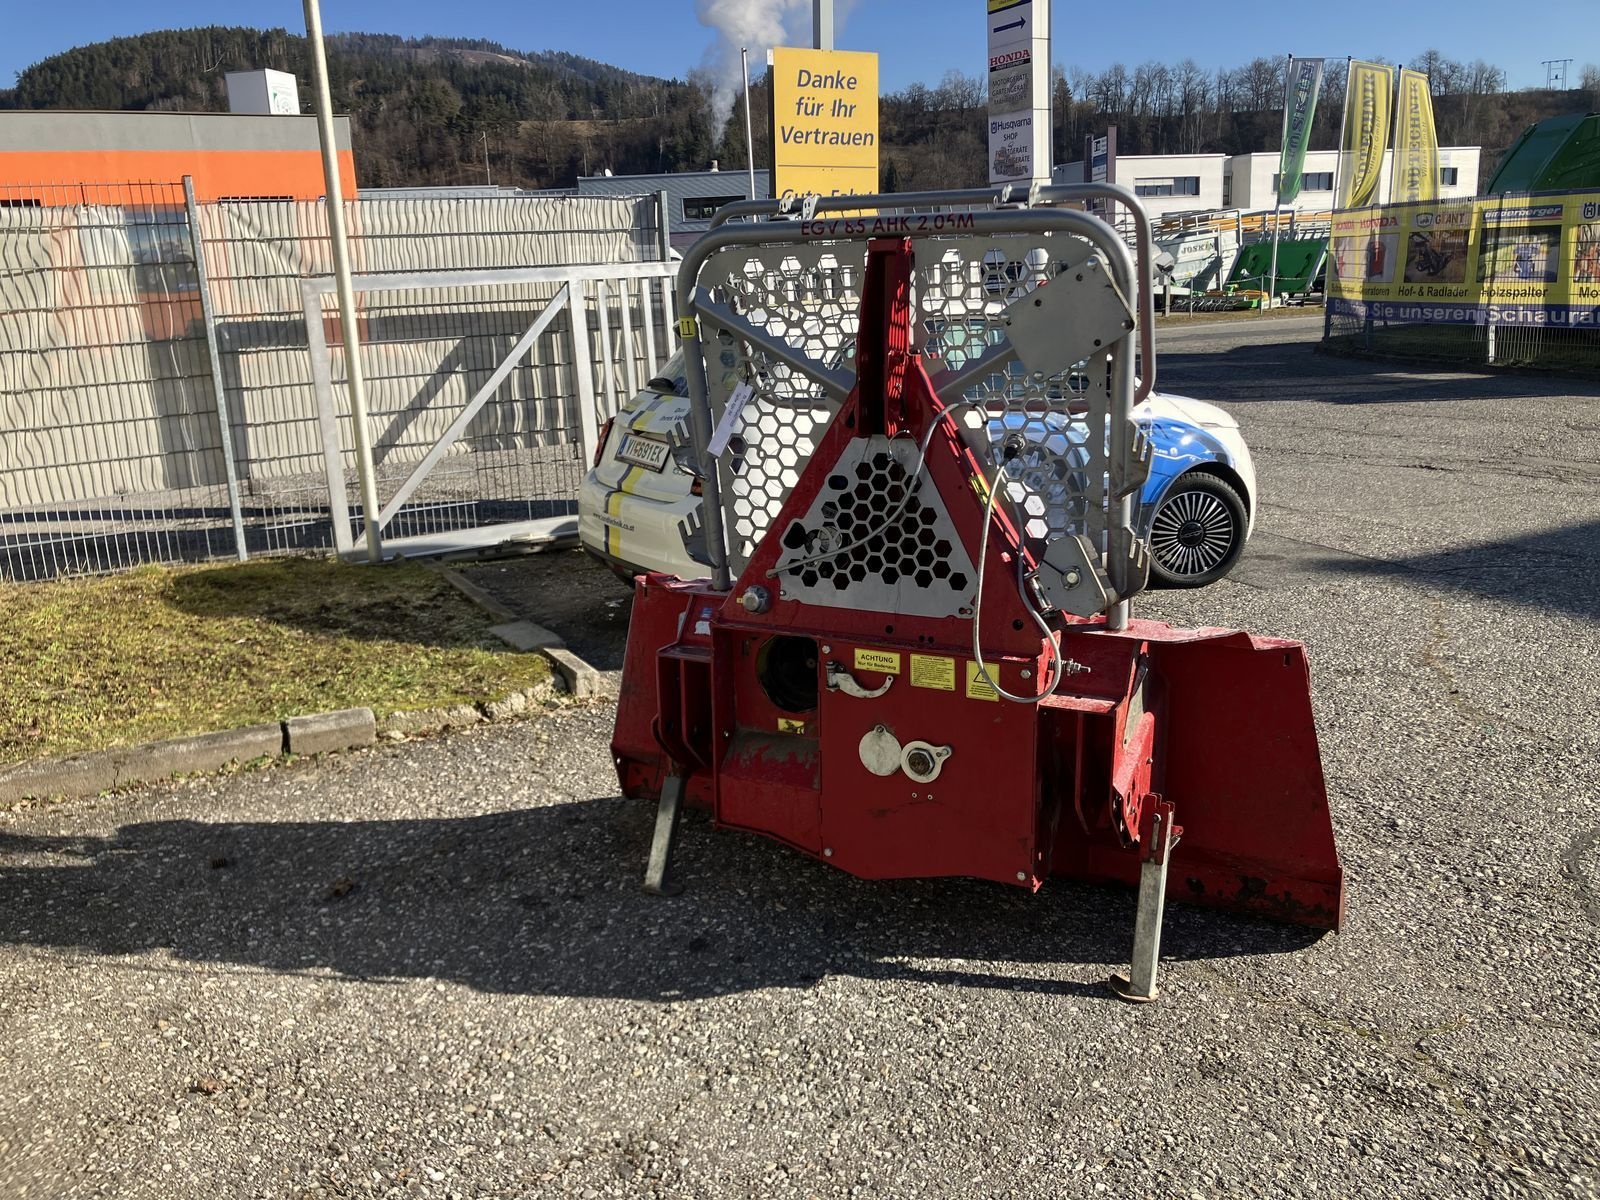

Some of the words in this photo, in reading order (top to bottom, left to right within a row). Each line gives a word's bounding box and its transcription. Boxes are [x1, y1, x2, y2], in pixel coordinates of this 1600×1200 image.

[990, 49, 1030, 66] HONDA
[797, 69, 857, 89] Danke
[796, 96, 824, 116] für
[831, 98, 856, 117] Ihr
[997, 118, 1031, 131] Husqvarna
[781, 125, 874, 146] Vertrauen
[1003, 132, 1018, 141] SHOP
[1360, 216, 1399, 229] HONDA
[1435, 212, 1466, 225] GIANT
[801, 219, 839, 236] EGV
[872, 216, 909, 233] AHK
[1181, 241, 1214, 254] JOSKIN
[1397, 286, 1416, 297] Hof-
[1418, 287, 1425, 296] &
[1426, 286, 1469, 297] Radlader
[1373, 302, 1394, 318] Sie
[1399, 307, 1477, 321] unseren
[1488, 304, 1600, 323] Schaura
[860, 653, 894, 664] ACHTUNG
